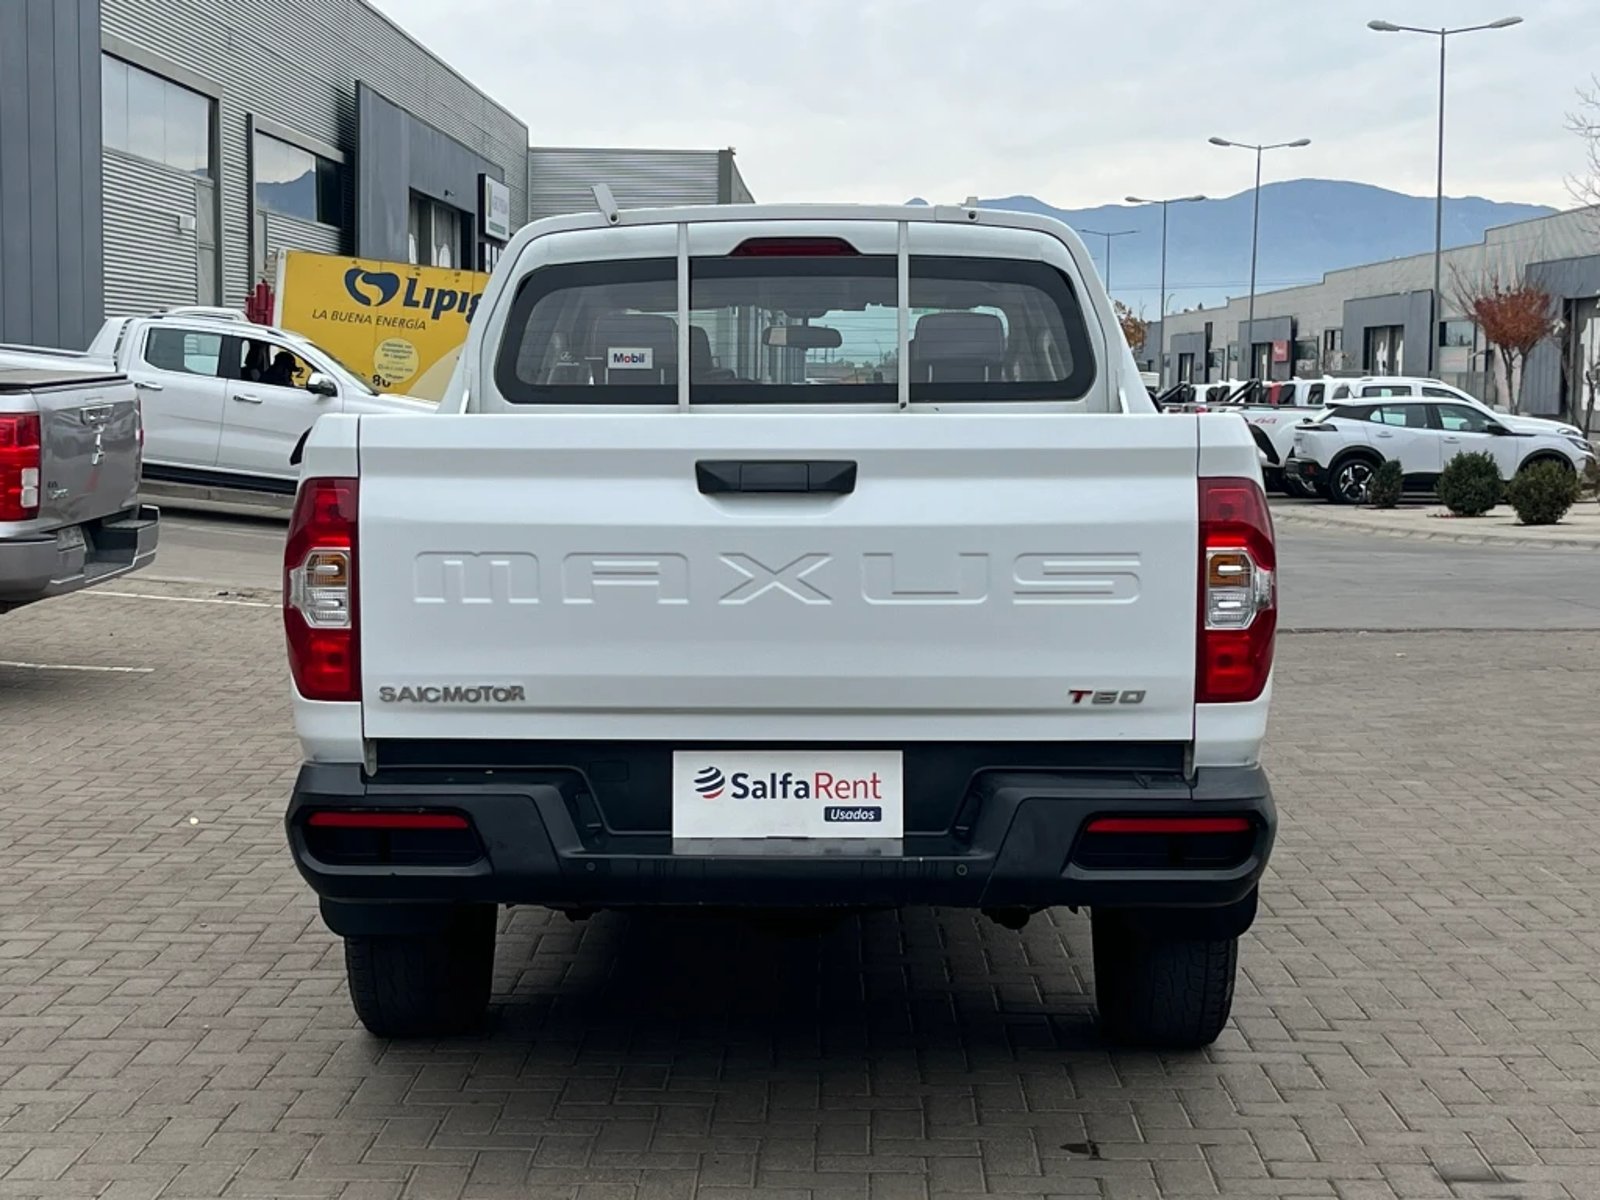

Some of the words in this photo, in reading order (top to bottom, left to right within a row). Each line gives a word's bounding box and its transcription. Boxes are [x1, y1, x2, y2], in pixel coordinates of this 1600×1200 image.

[312, 309, 328, 320] LA
[331, 310, 373, 325] BUENA
[376, 316, 426, 330] ENERGÍA
[613, 353, 645, 363] Mobil
[414, 551, 1142, 605] MAXUS
[379, 685, 525, 703] SAICMOTOR
[1068, 690, 1146, 704] T60
[731, 772, 882, 800] SalfaRent
[830, 808, 875, 821] Usados
